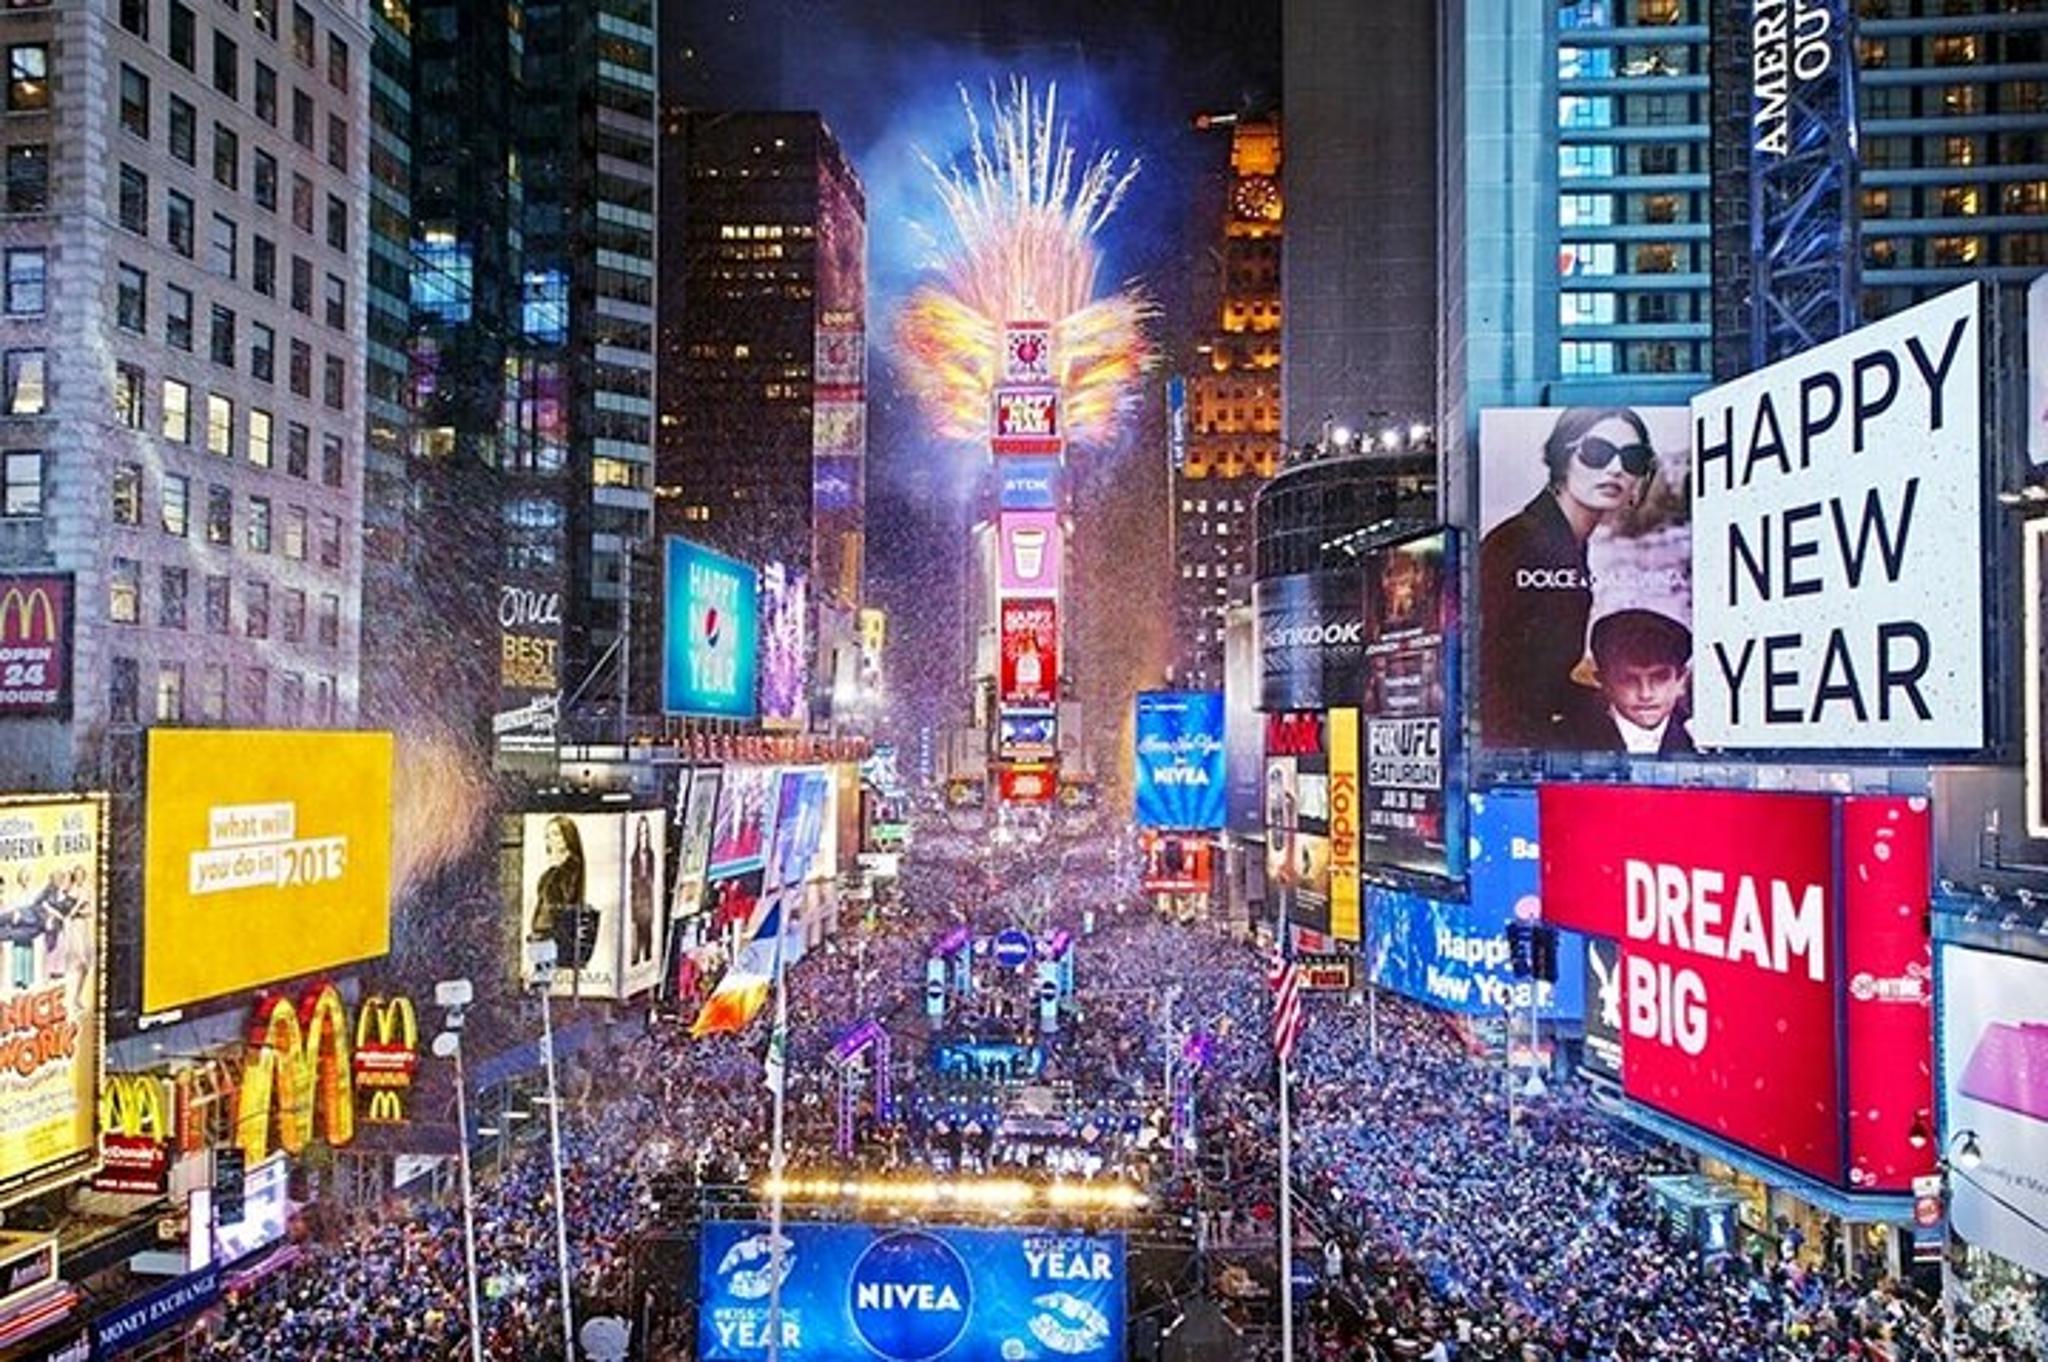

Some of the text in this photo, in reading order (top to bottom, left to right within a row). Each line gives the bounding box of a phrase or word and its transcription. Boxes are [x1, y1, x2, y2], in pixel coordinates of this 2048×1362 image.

[1697, 315, 1969, 500] HAPPY
[1728, 476, 1921, 608] NEW
[689, 562, 739, 606] HAPPY
[1516, 568, 1578, 588] DOLCE
[0, 647, 52, 662] OPEN
[502, 633, 558, 665] BEST
[4, 664, 46, 687] 24
[688, 648, 737, 694] YEAR
[1713, 620, 1934, 726] YEAR
[0, 689, 58, 703] OURS
[1154, 766, 1210, 785] NIVEA
[215, 812, 257, 838] what
[197, 859, 228, 890] you
[233, 852, 256, 877] do
[274, 842, 347, 889] 2013
[1625, 858, 1826, 982] DREAM
[1427, 962, 1471, 1003] New
[1626, 953, 1709, 1056] BIG
[1023, 1250, 1114, 1280] YEAR
[857, 1283, 963, 1312] NIVEA
